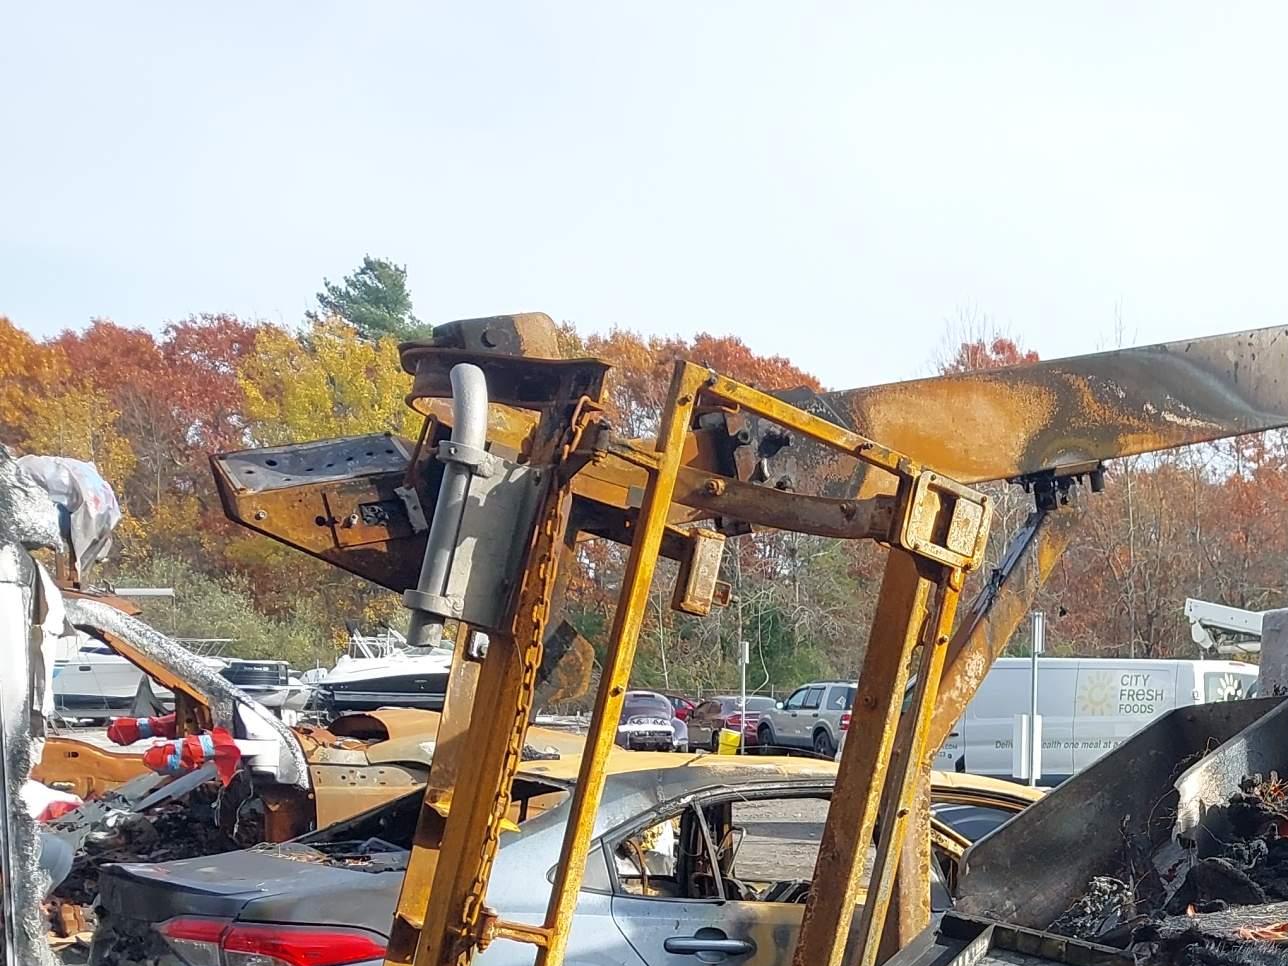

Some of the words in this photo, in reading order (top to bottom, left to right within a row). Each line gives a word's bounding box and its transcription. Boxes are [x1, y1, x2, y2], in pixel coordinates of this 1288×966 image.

[1120, 674, 1150, 686] CITY
[1118, 704, 1154, 714] FOODS
[1081, 740, 1101, 749] meal
